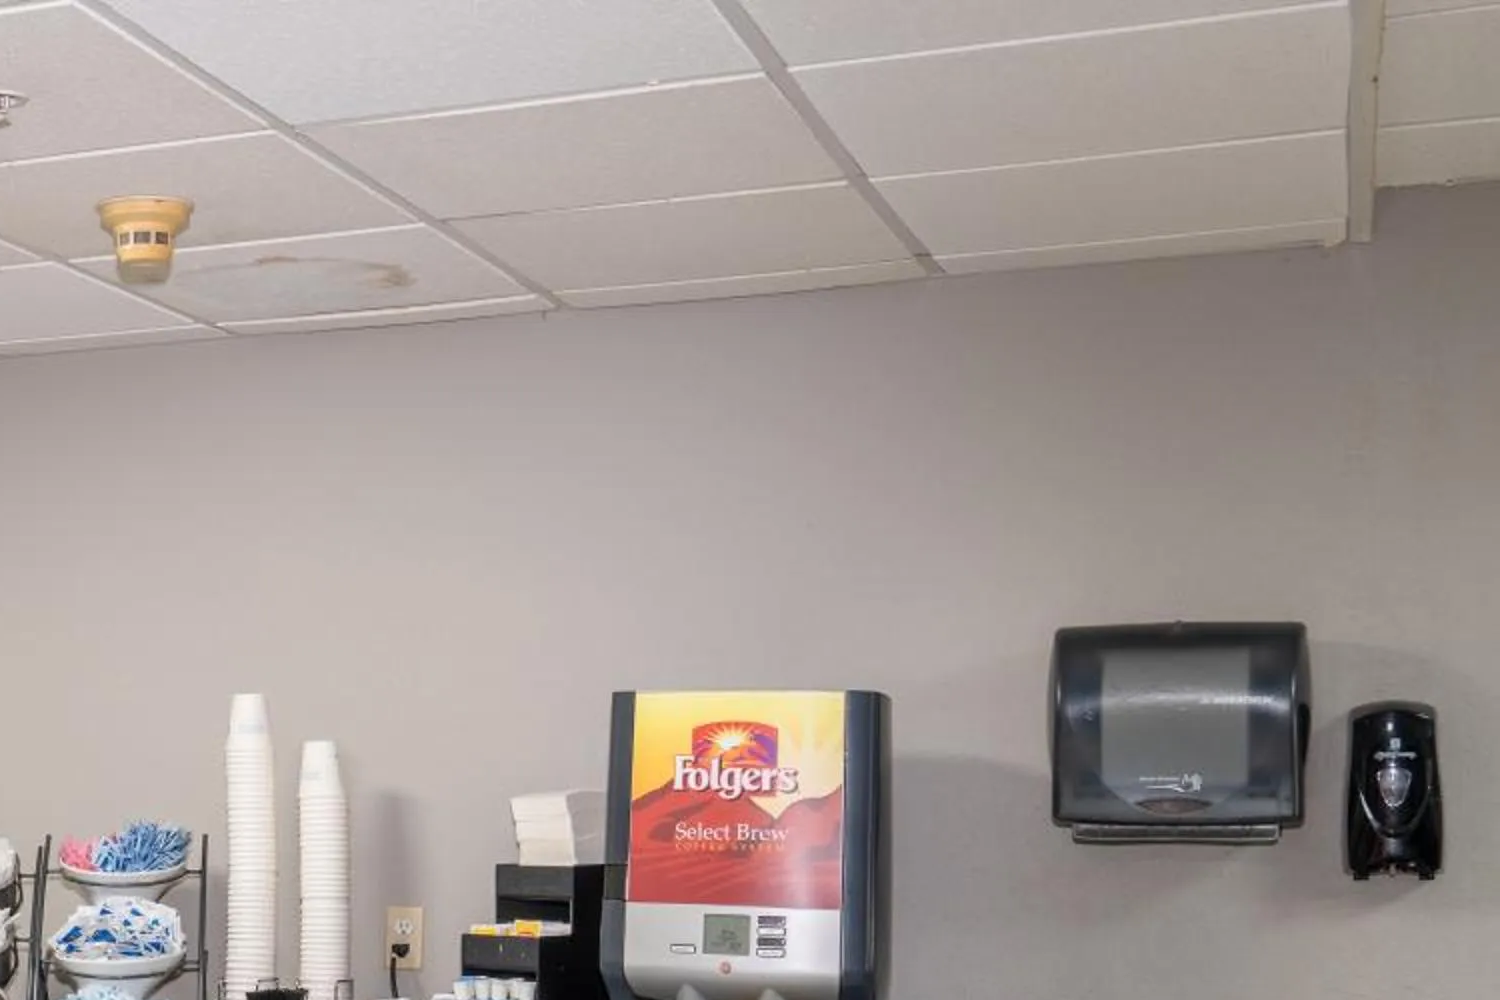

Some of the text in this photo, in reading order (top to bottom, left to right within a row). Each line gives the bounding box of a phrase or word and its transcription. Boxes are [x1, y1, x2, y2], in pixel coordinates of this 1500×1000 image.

[672, 754, 799, 800] Folgers
[674, 821, 789, 842] Select Brew
